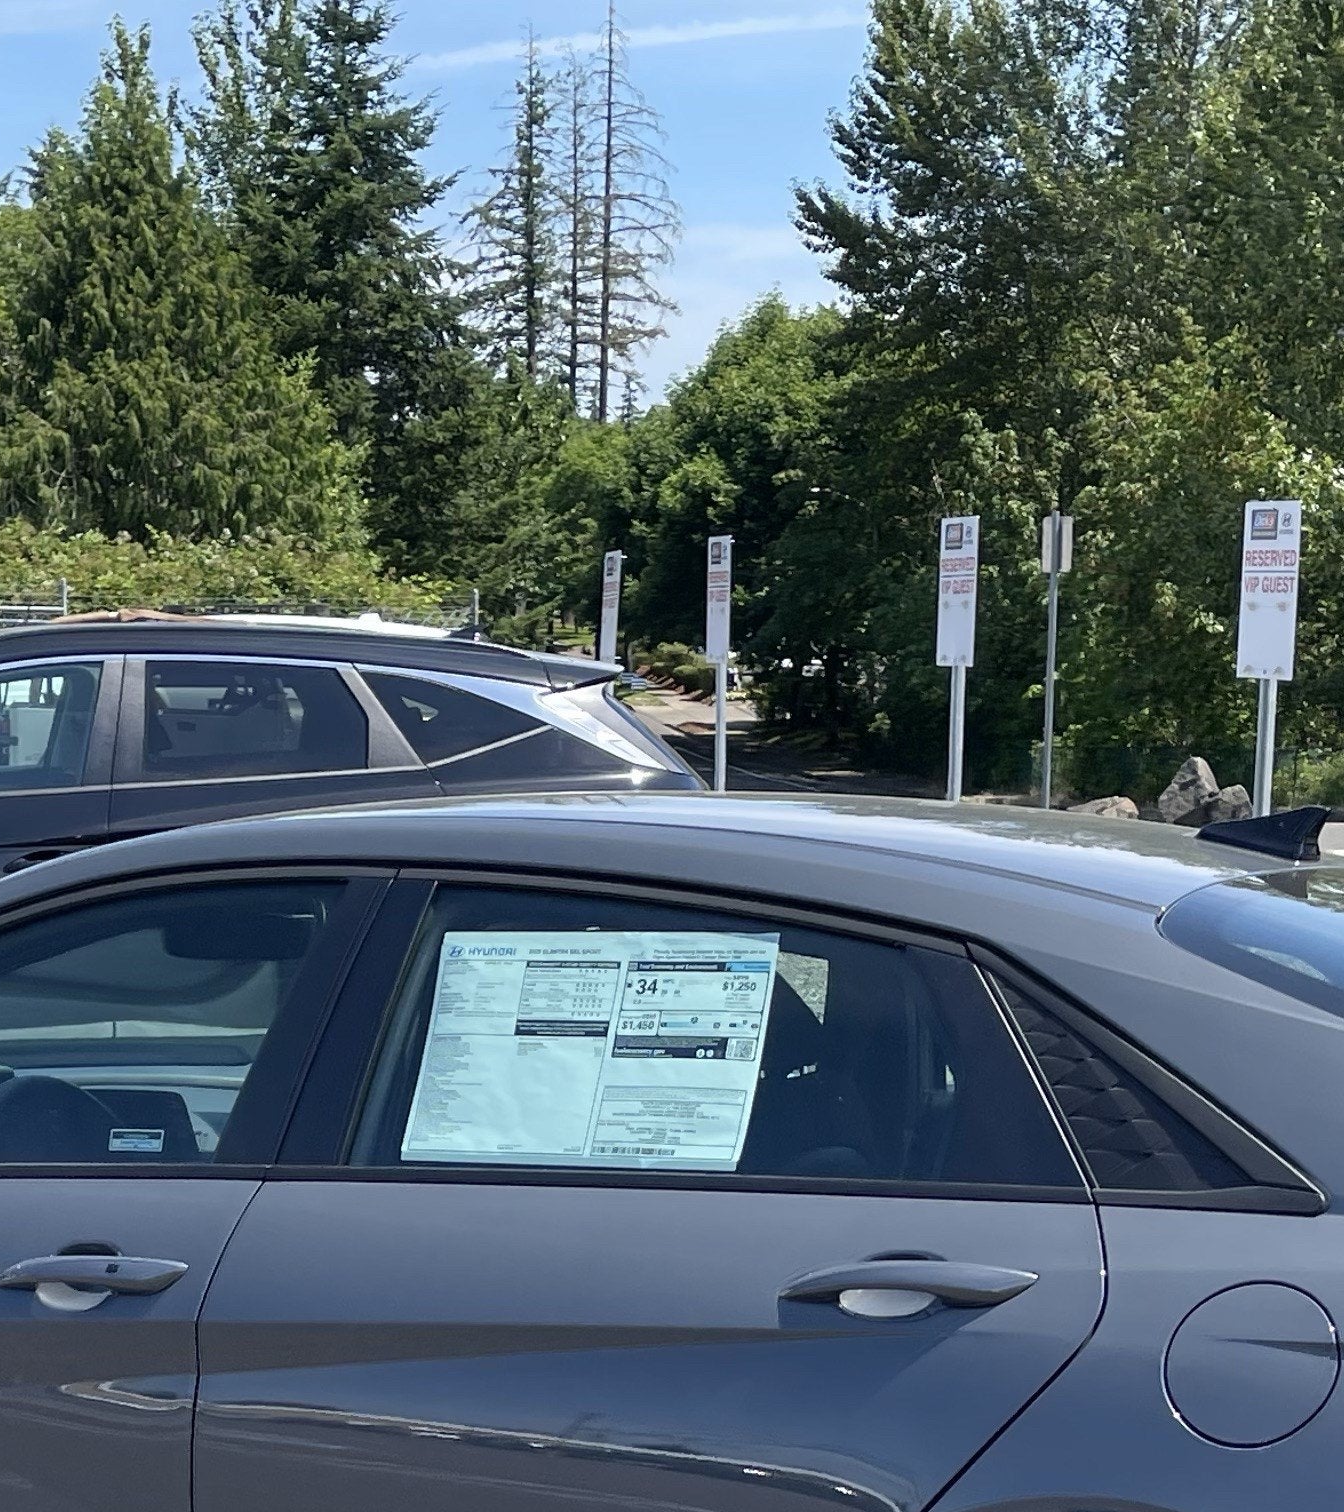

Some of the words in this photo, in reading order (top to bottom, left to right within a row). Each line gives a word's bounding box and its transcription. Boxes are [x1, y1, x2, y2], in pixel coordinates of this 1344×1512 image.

[1244, 549, 1297, 567] RESERVED
[1244, 577, 1259, 594] VIP
[1262, 576, 1296, 594] GUEST
[468, 945, 517, 957] HYUNDAI
[635, 978, 658, 995] 34
[722, 981, 757, 992] $1,250
